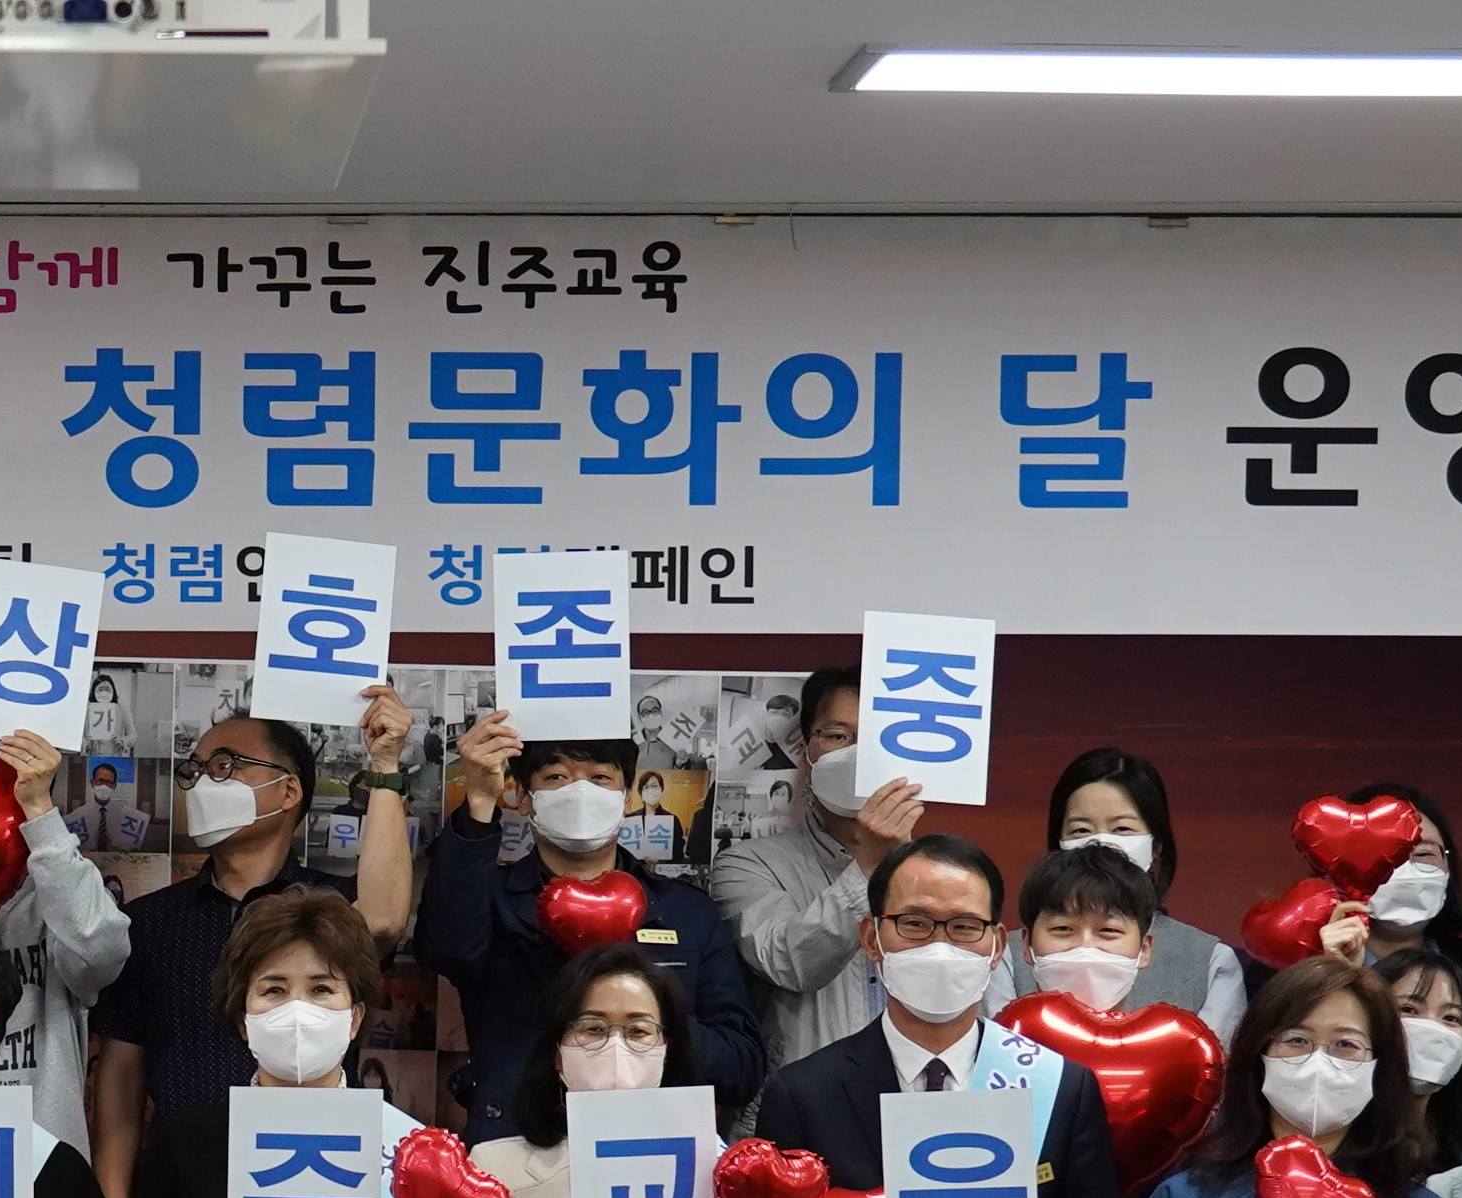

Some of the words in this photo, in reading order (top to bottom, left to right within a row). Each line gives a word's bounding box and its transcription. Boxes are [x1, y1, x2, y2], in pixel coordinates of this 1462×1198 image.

[166, 241, 377, 314] 가꾸는
[422, 240, 689, 314] 진주교육
[60, 347, 903, 508] 청렴문화의
[999, 352, 1153, 509] 달
[267, 574, 379, 679] 호
[428, 544, 755, 605] 청페인
[508, 589, 622, 699] 존
[873, 648, 983, 763] 중
